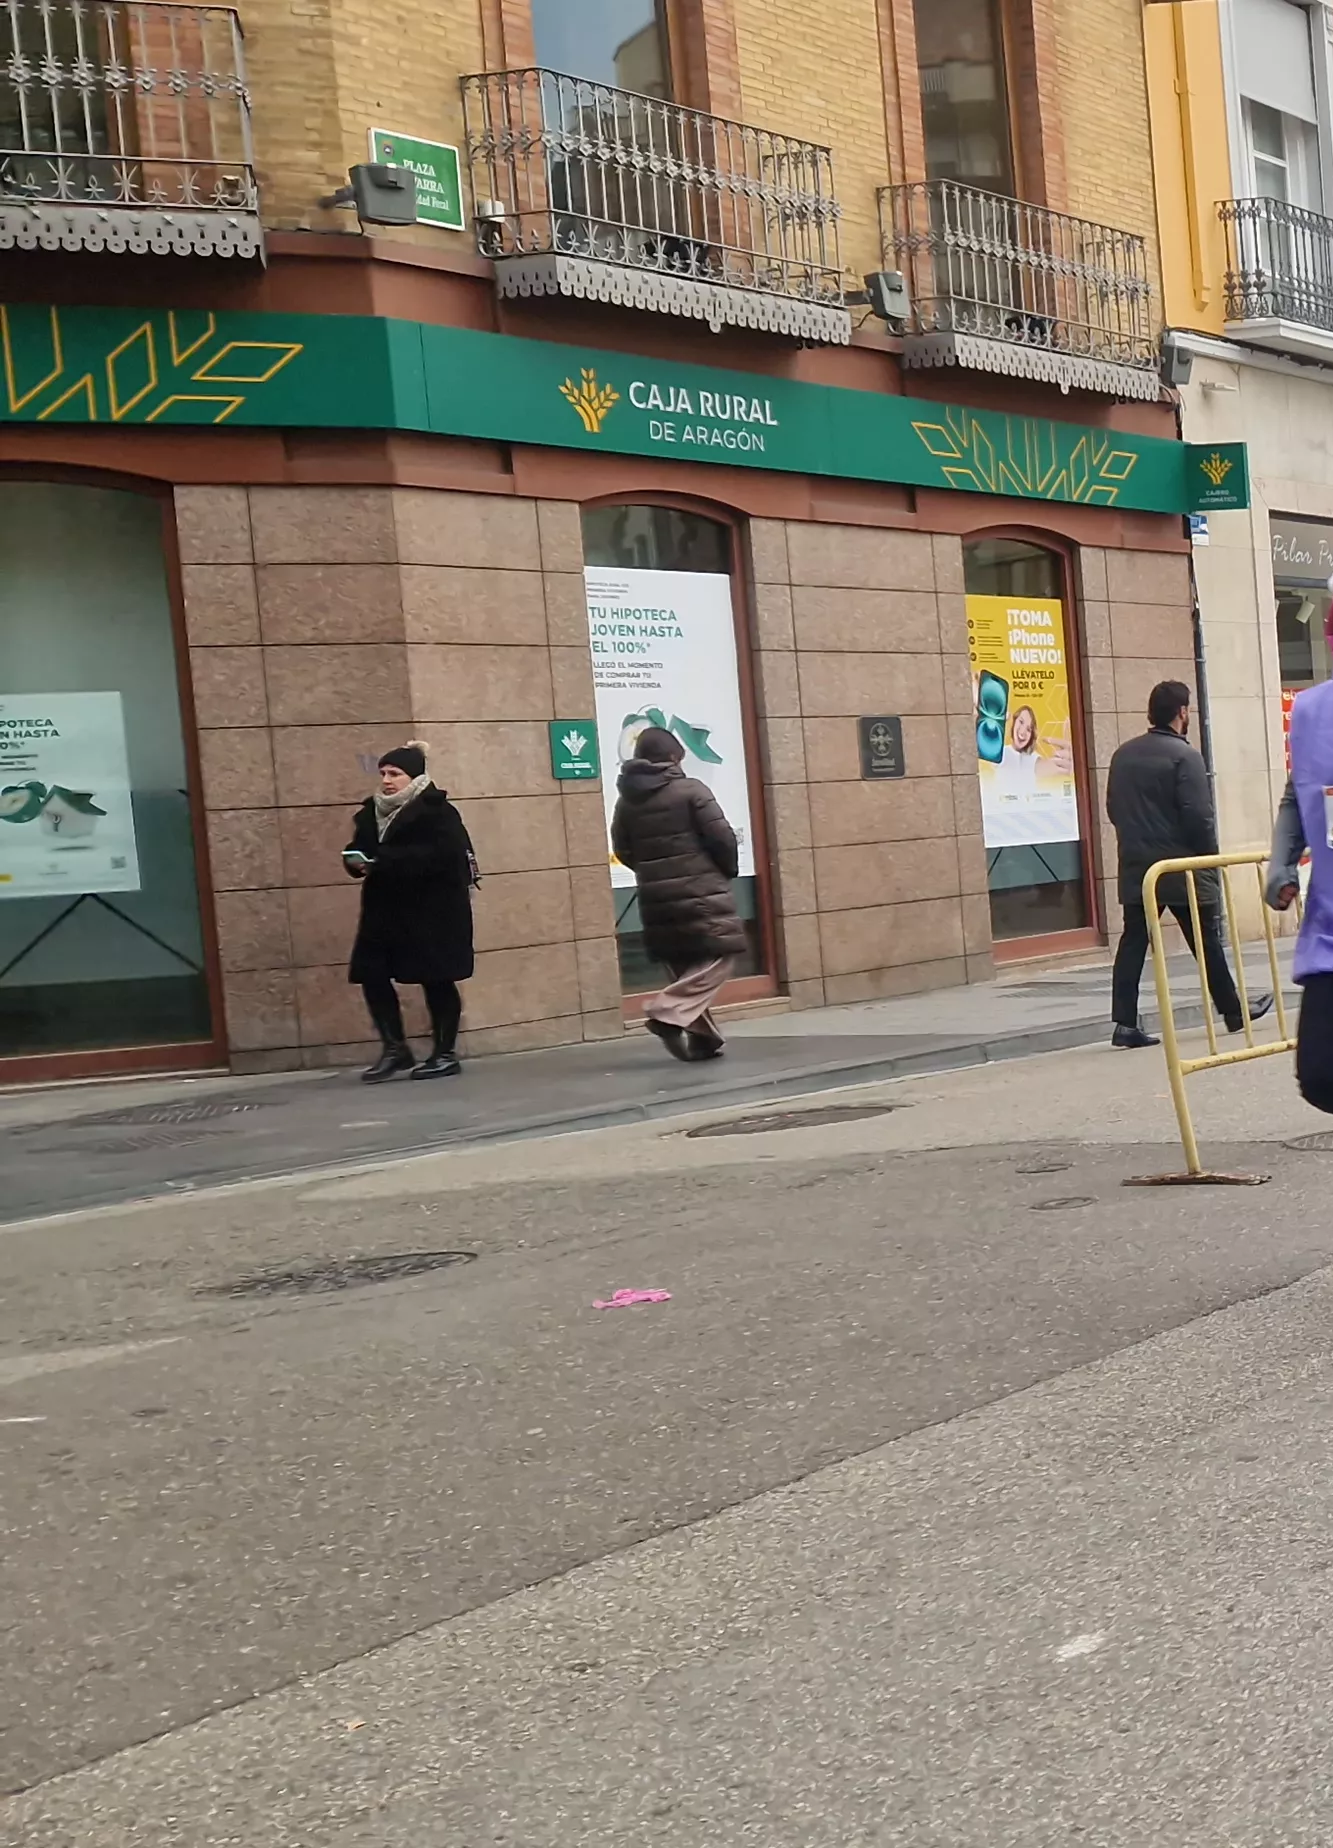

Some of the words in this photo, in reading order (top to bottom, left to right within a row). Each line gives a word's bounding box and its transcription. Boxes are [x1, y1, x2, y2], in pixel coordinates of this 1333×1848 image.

[403, 159, 436, 176] PLAZA
[415, 176, 445, 194] ARRA
[629, 381, 694, 414] CAJA
[699, 390, 778, 426] RURAL
[650, 420, 677, 442] DE
[682, 425, 765, 451] ARAGÓN
[1273, 534, 1313, 565] Pilar
[588, 606, 607, 619] TU
[611, 607, 677, 621] HIPOTECA
[1007, 609, 1052, 627] ¡TOMA
[591, 624, 635, 636] JOVEN
[640, 625, 684, 638] HASTA
[1009, 629, 1055, 646] iPhone
[592, 641, 608, 653] EL
[1010, 648, 1062, 664] NUEVO!
[1012, 668, 1055, 680] LLÉVATELO
[1013, 681, 1029, 690] POR
[1031, 682, 1036, 690] 0
[13, 729, 60, 738] HASTA
